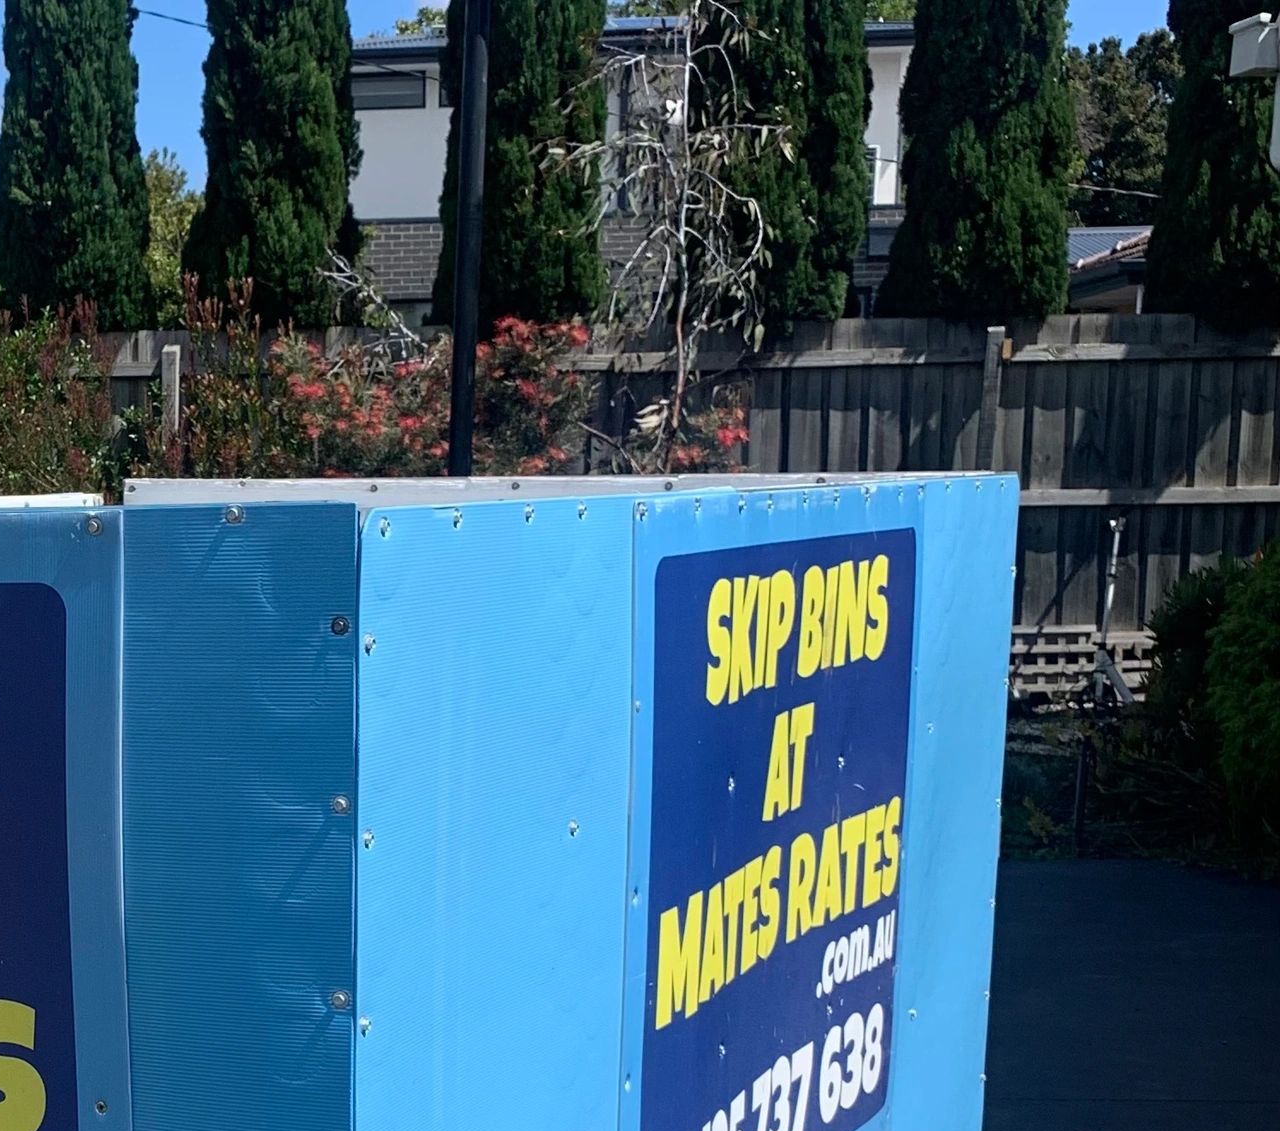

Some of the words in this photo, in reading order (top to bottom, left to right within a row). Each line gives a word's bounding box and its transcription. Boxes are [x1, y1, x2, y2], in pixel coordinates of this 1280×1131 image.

[706, 570, 796, 706] SKIP
[797, 555, 889, 677] BINS
[762, 703, 814, 822] AT
[655, 847, 781, 1030] MATES
[786, 797, 901, 941] RATES
[818, 1002, 884, 1124] 638
